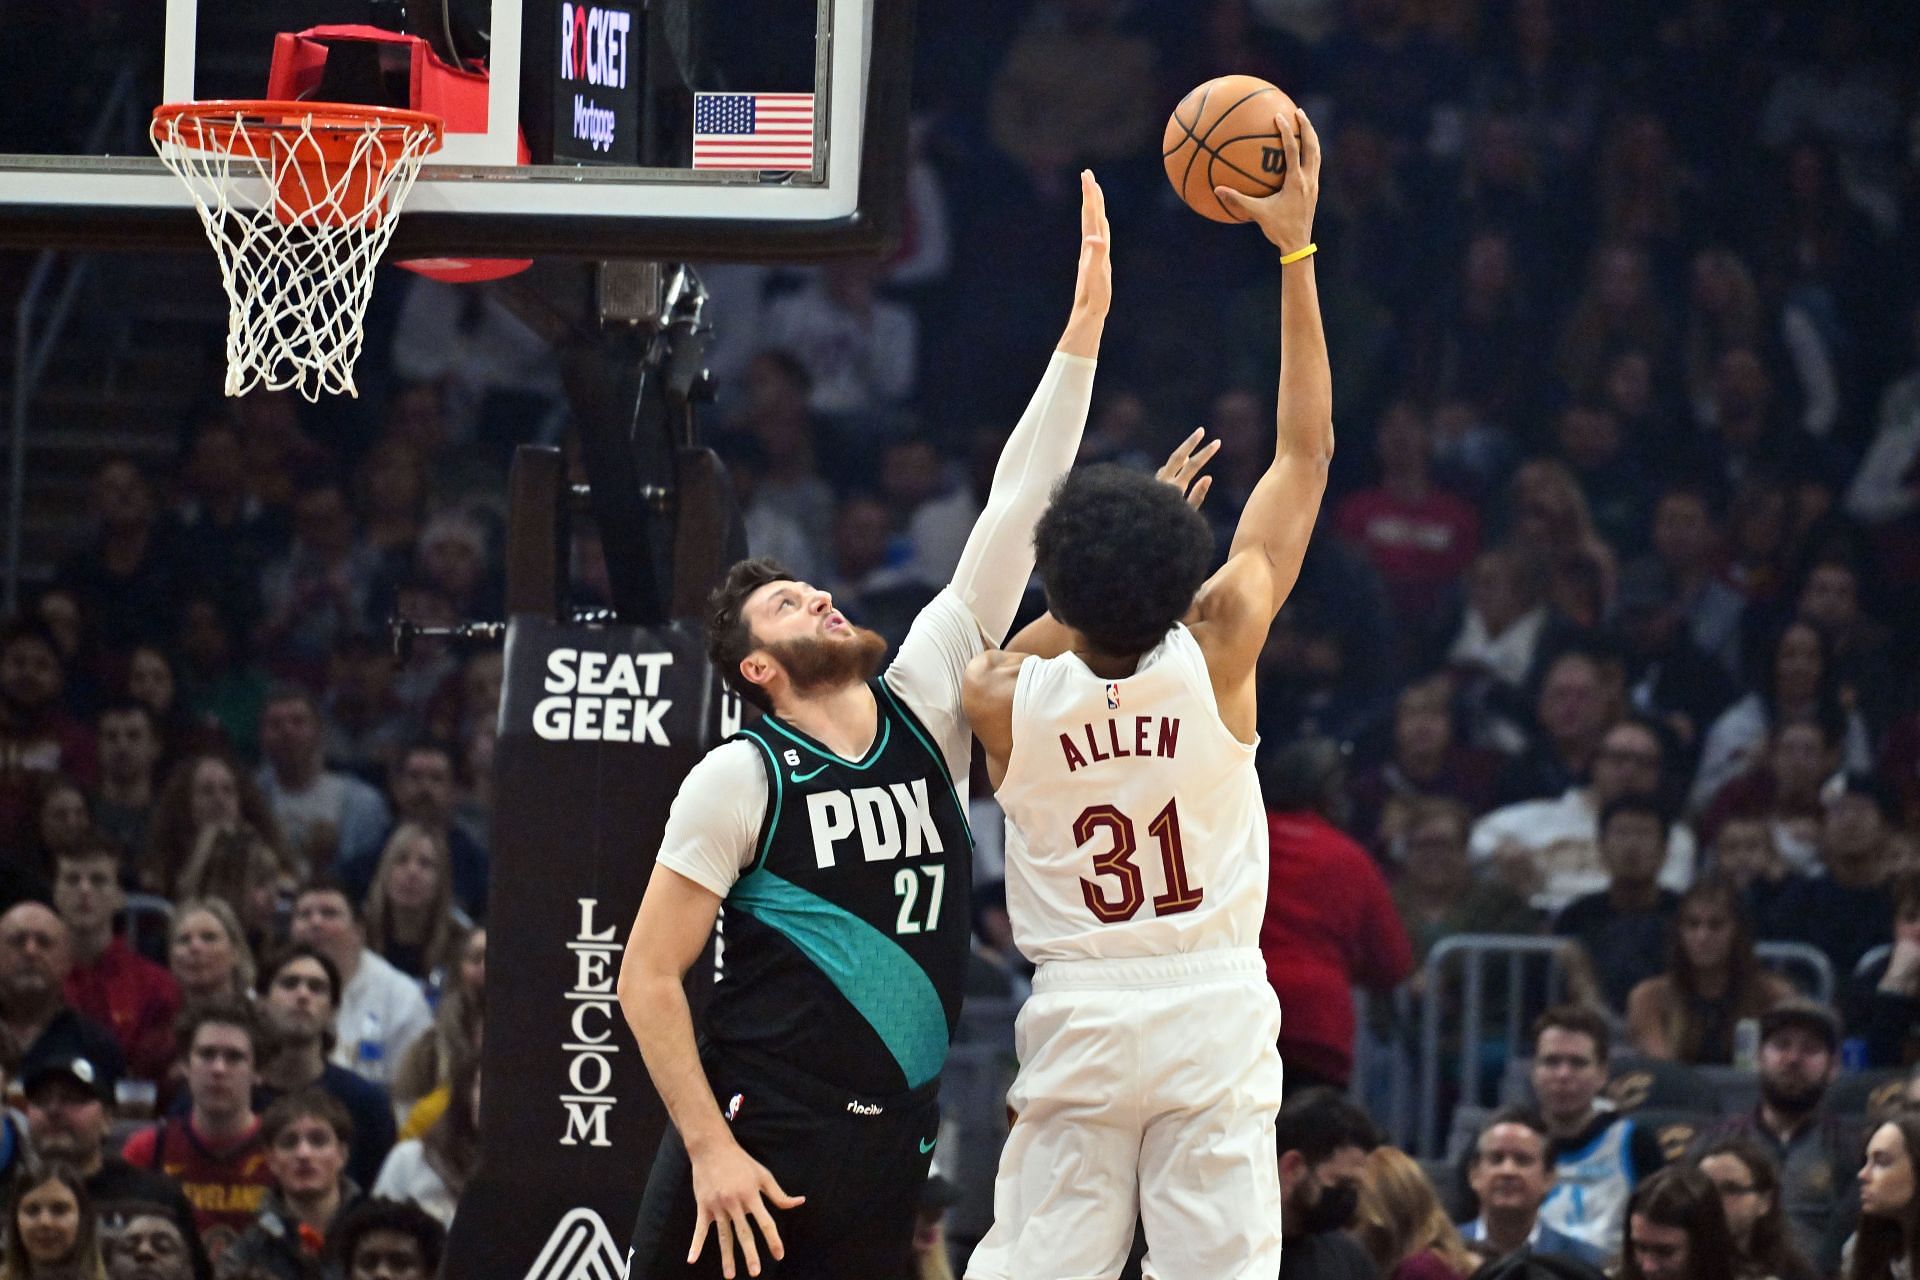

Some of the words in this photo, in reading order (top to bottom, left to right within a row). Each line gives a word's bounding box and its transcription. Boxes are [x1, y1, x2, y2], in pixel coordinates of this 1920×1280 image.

[562, 2, 630, 89] ROCKET
[574, 93, 615, 152] Mortgage
[544, 648, 673, 696] SEAT
[532, 696, 673, 747] GEEK
[1059, 716, 1180, 772] ALLEN
[806, 778, 944, 869] PDX
[1072, 796, 1203, 924] 31
[893, 864, 945, 935] 27
[559, 898, 620, 1147] LECOM
